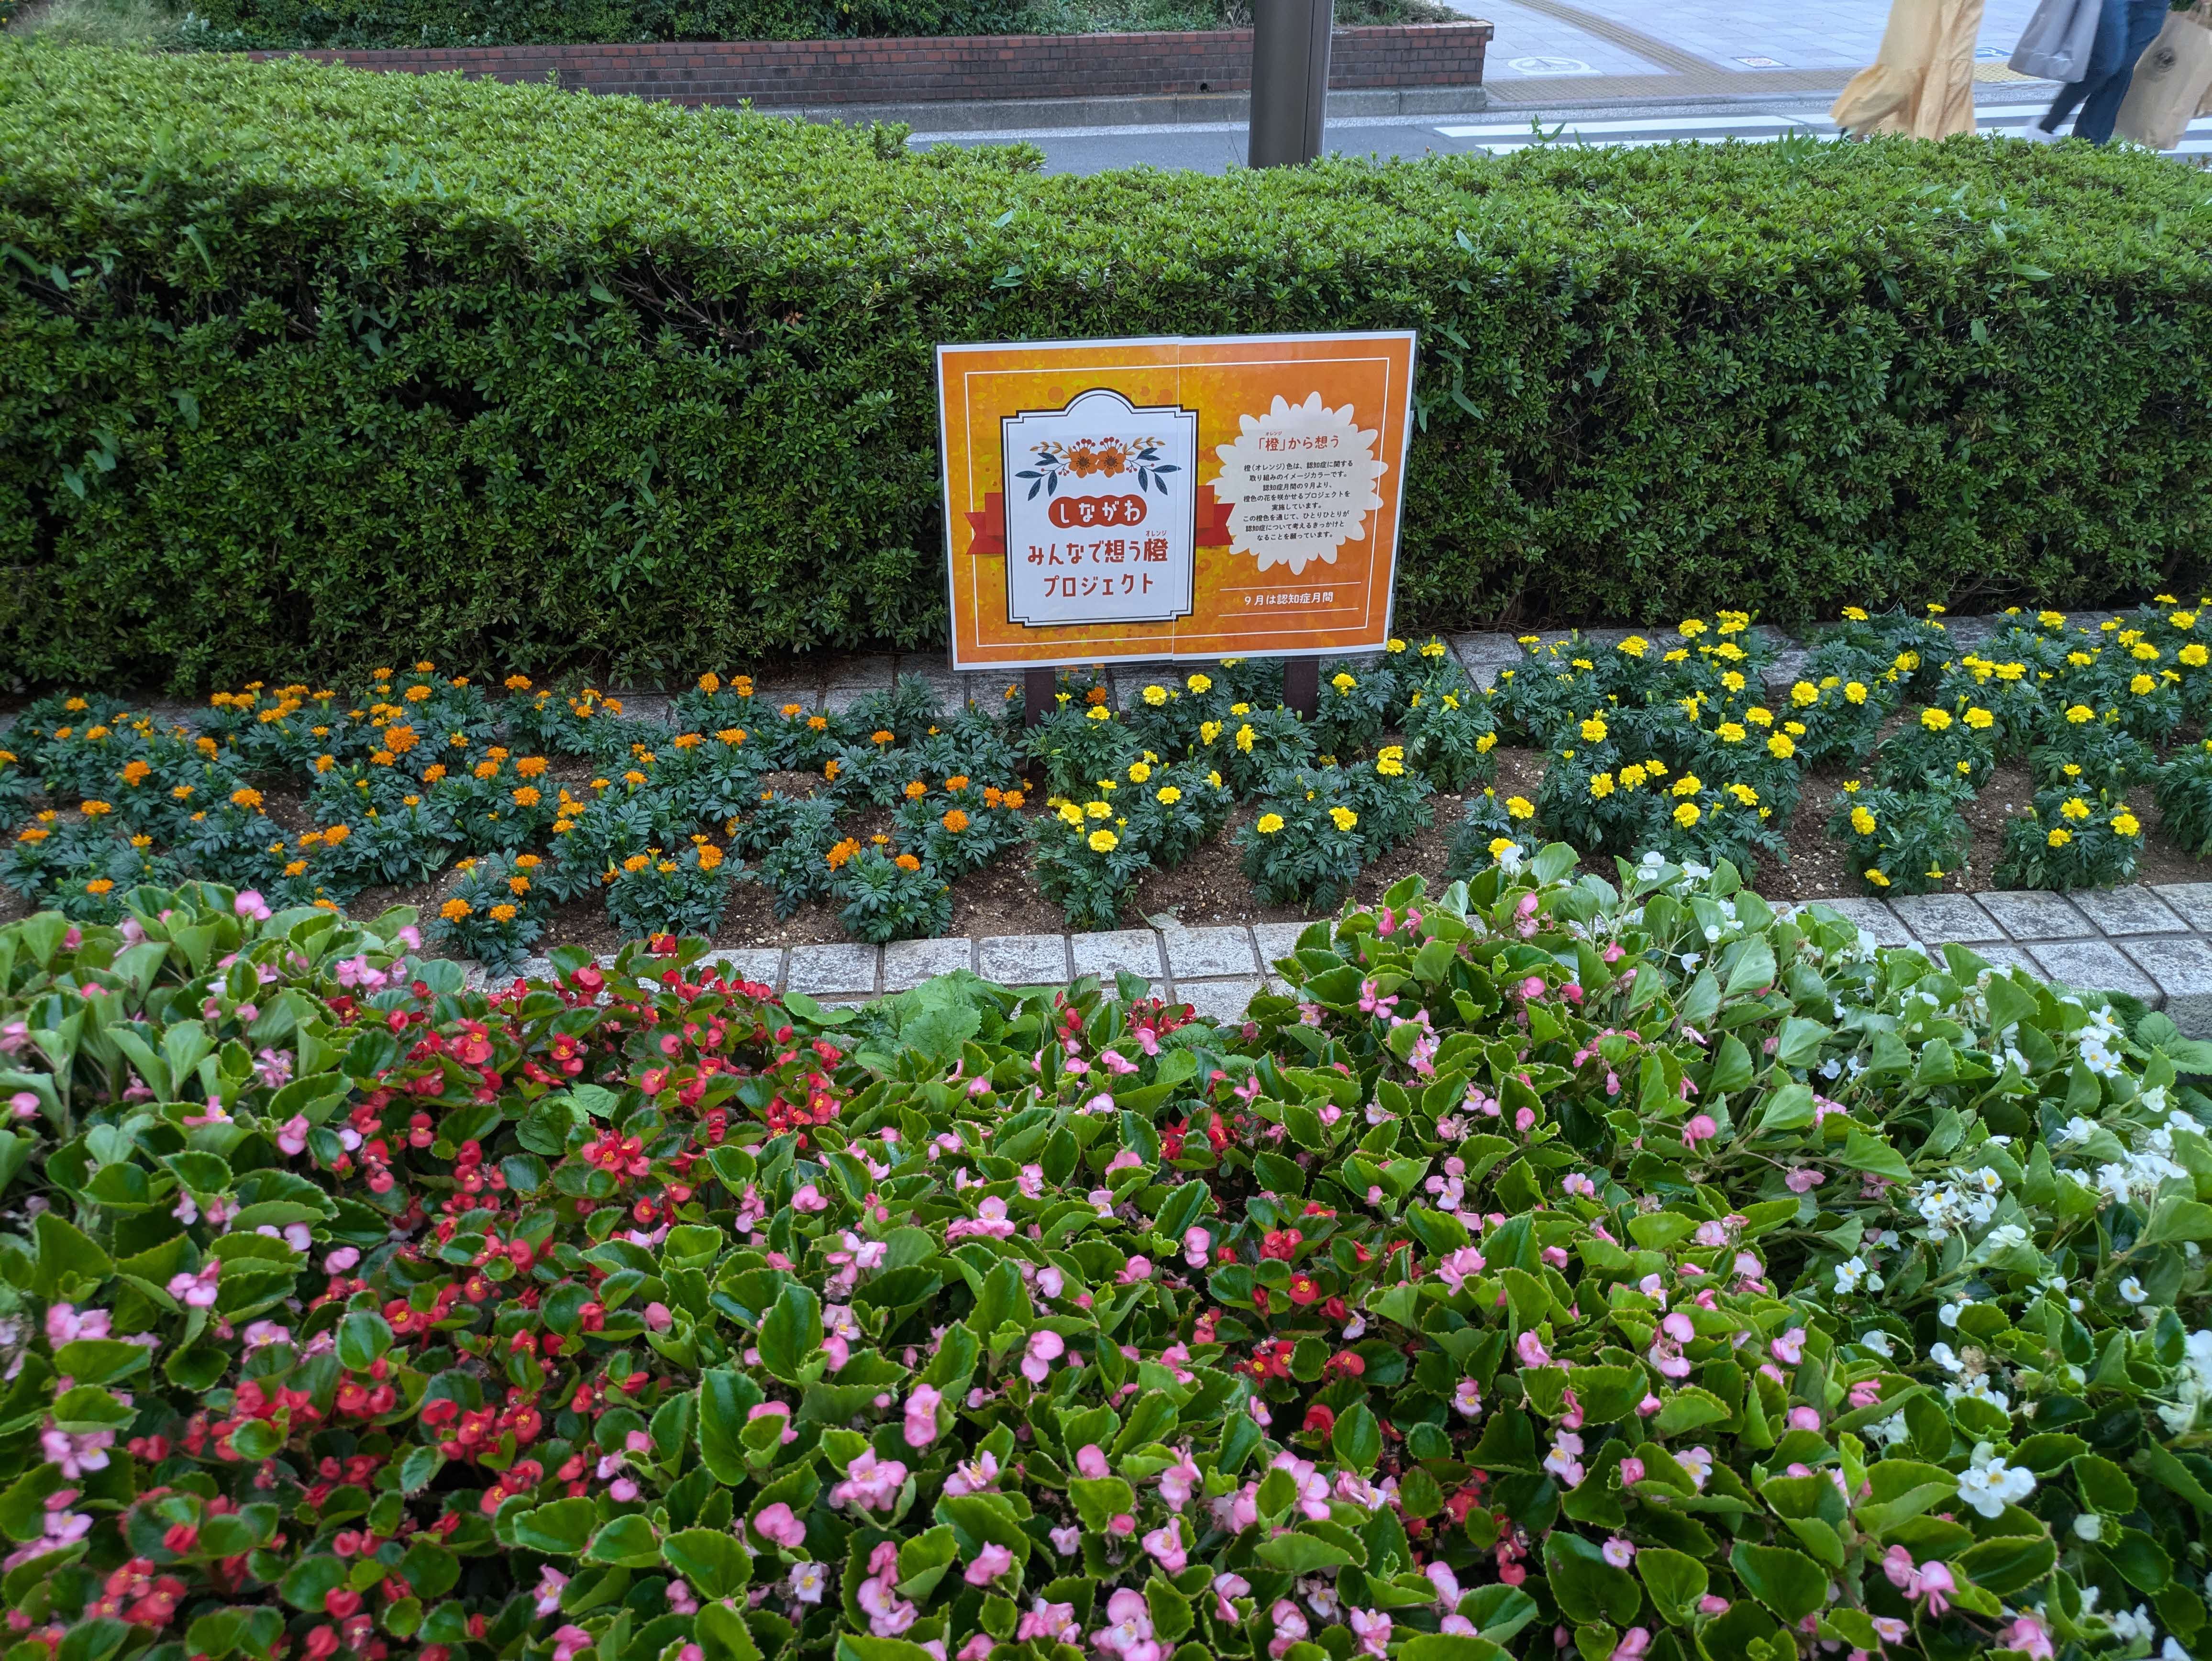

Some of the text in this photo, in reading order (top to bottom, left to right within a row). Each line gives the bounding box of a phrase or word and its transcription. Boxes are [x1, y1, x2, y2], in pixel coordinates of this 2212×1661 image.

[1259, 435, 1338, 451] 「橙」から想う
[1249, 470, 1348, 482] 取り組みのイメージカラーです。
[1263, 482, 1332, 491] 認知症月間の9月より、
[1244, 490, 1350, 502] 橙色の花を咲かせるプロジェクトを
[1060, 500, 1140, 523] しながわ
[1272, 502, 1322, 511] 実施しています。
[1243, 510, 1349, 522] この橙色を通じて、ひとりひとりが
[1245, 520, 1345, 532] 認知症について考えるきっかけと
[1257, 531, 1333, 541] なることを願っています。
[1028, 538, 1168, 566] みんなで想う橙
[1044, 573, 1153, 598] プロジェクト
